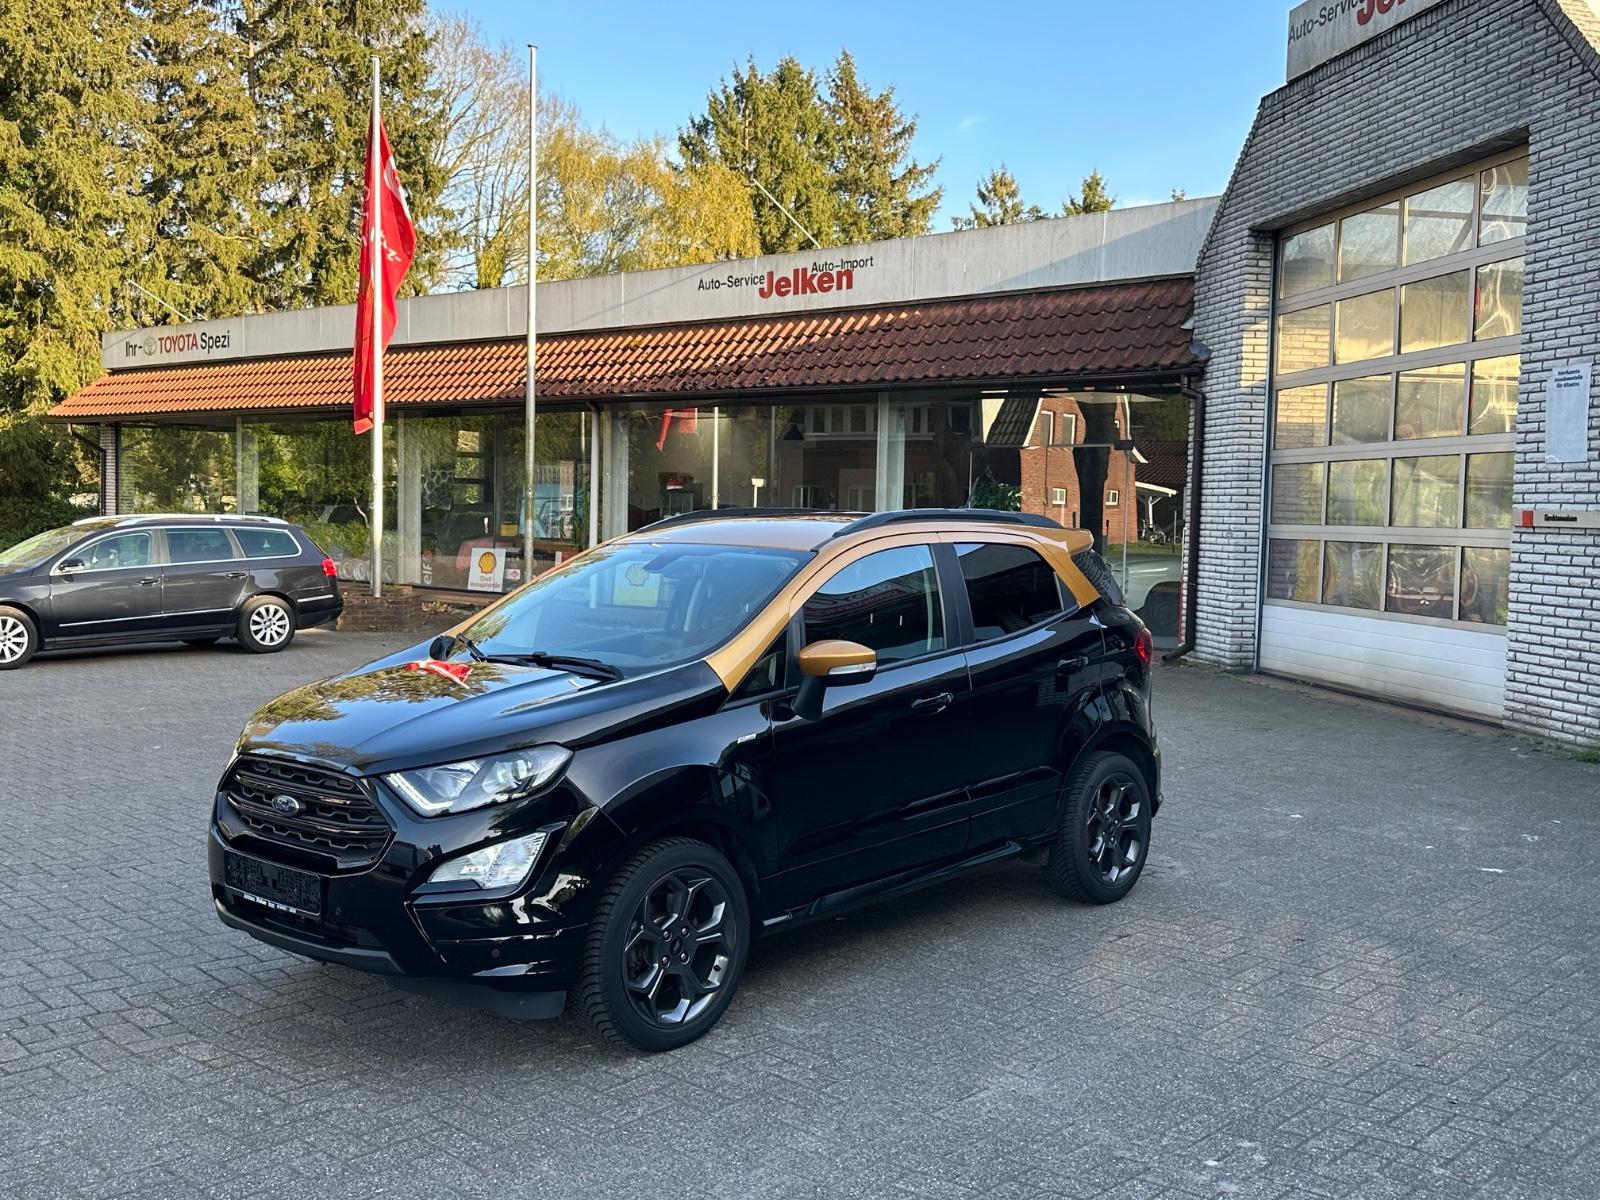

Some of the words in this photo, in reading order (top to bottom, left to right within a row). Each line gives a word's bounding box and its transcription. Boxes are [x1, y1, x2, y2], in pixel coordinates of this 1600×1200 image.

[811, 256, 874, 273] Auto-Import
[697, 273, 765, 291] Auto-Service
[758, 267, 854, 299] Jelken
[125, 341, 143, 357] Ihr-
[158, 333, 198, 354] TOYOTA
[200, 330, 230, 354] Spezi
